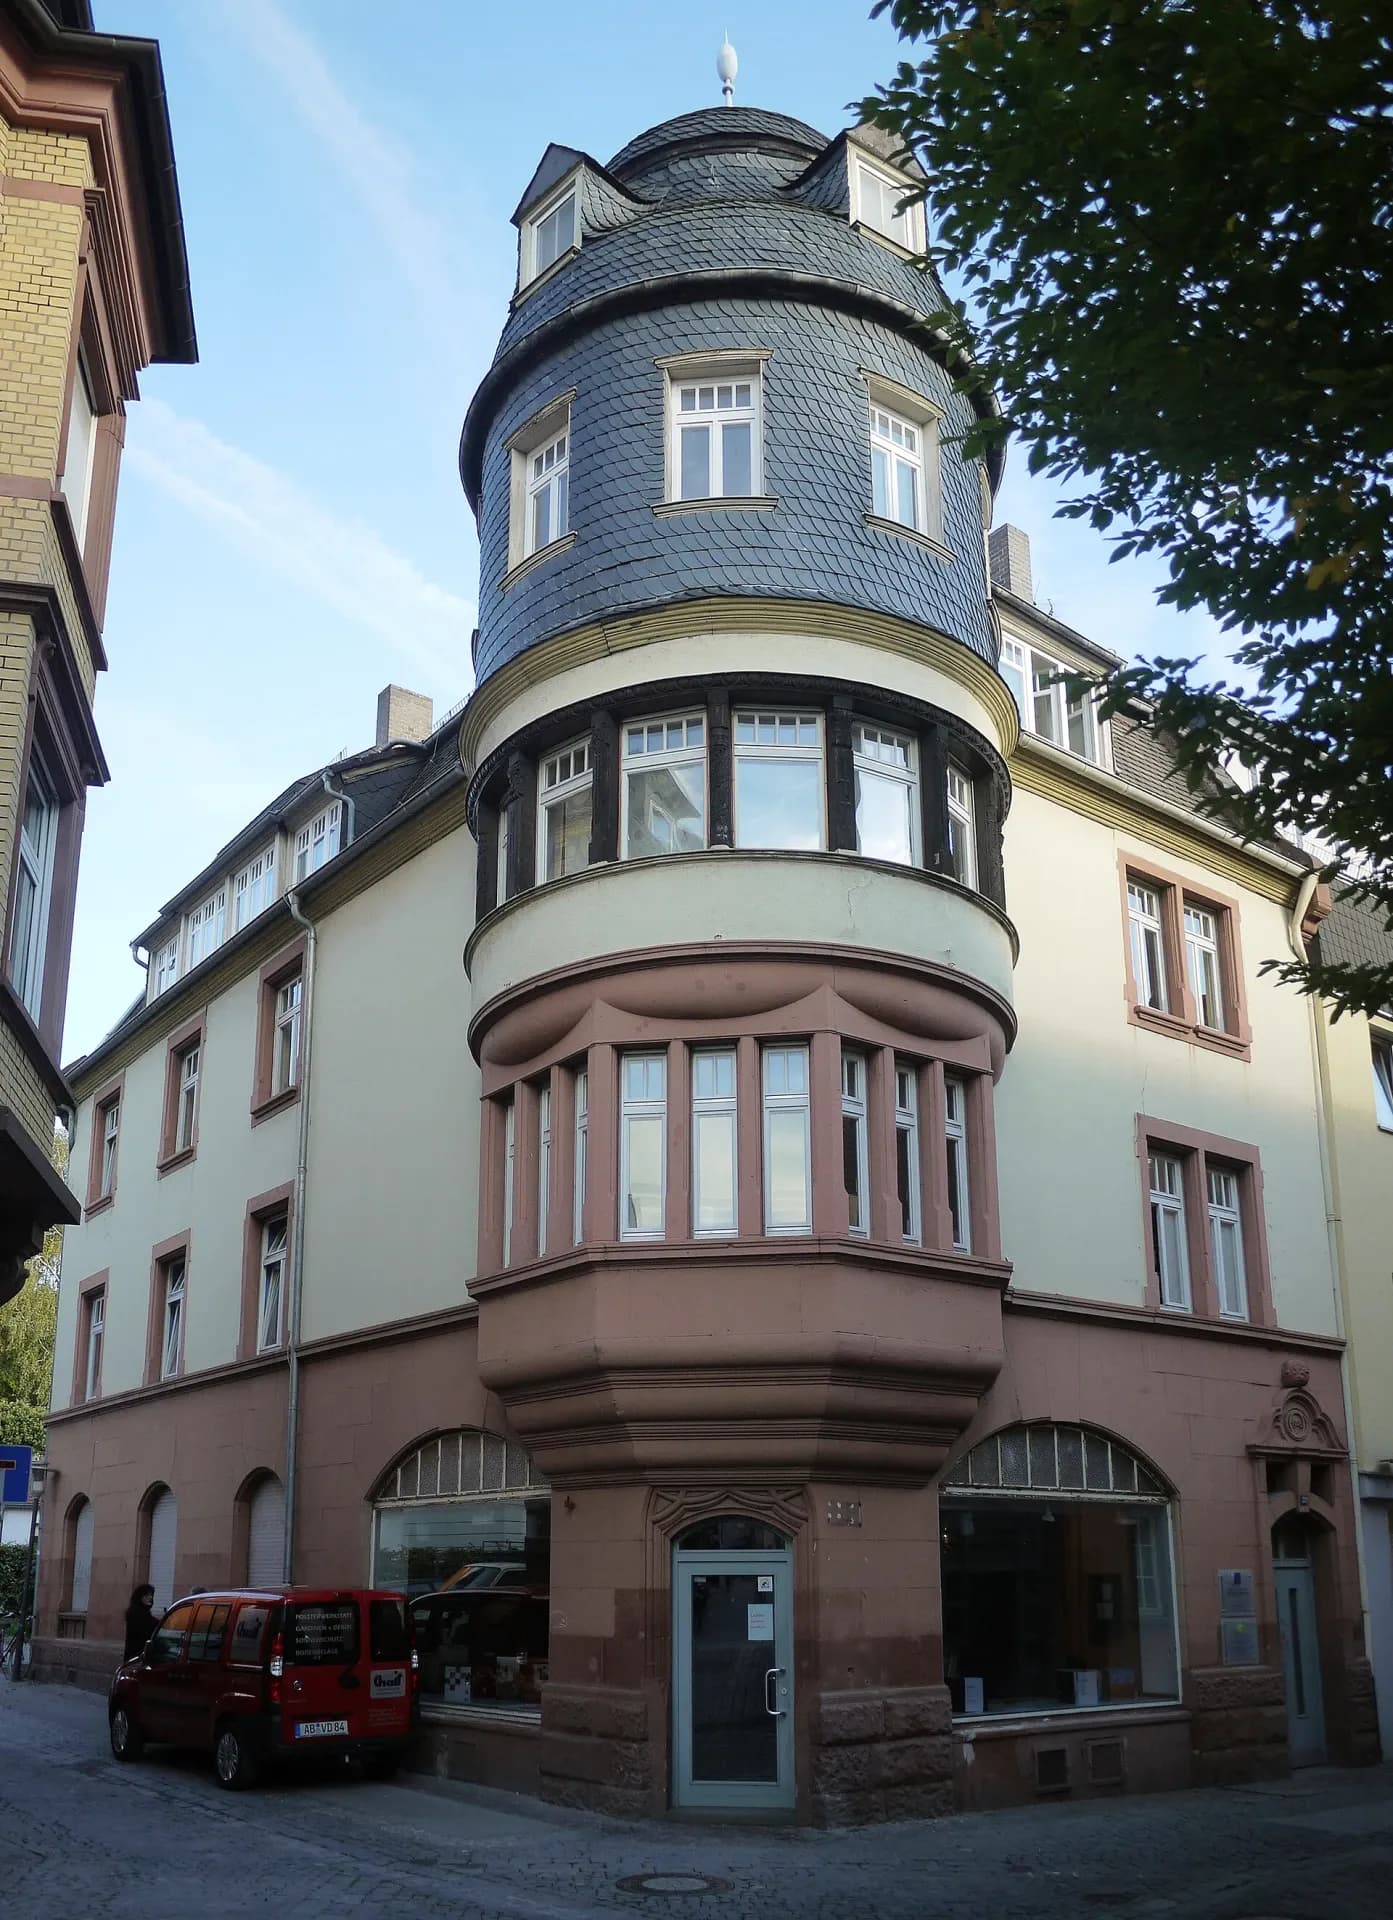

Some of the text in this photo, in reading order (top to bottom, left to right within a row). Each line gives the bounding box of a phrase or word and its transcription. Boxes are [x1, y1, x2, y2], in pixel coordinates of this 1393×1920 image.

[304, 1721, 345, 1734] AB VD 84
